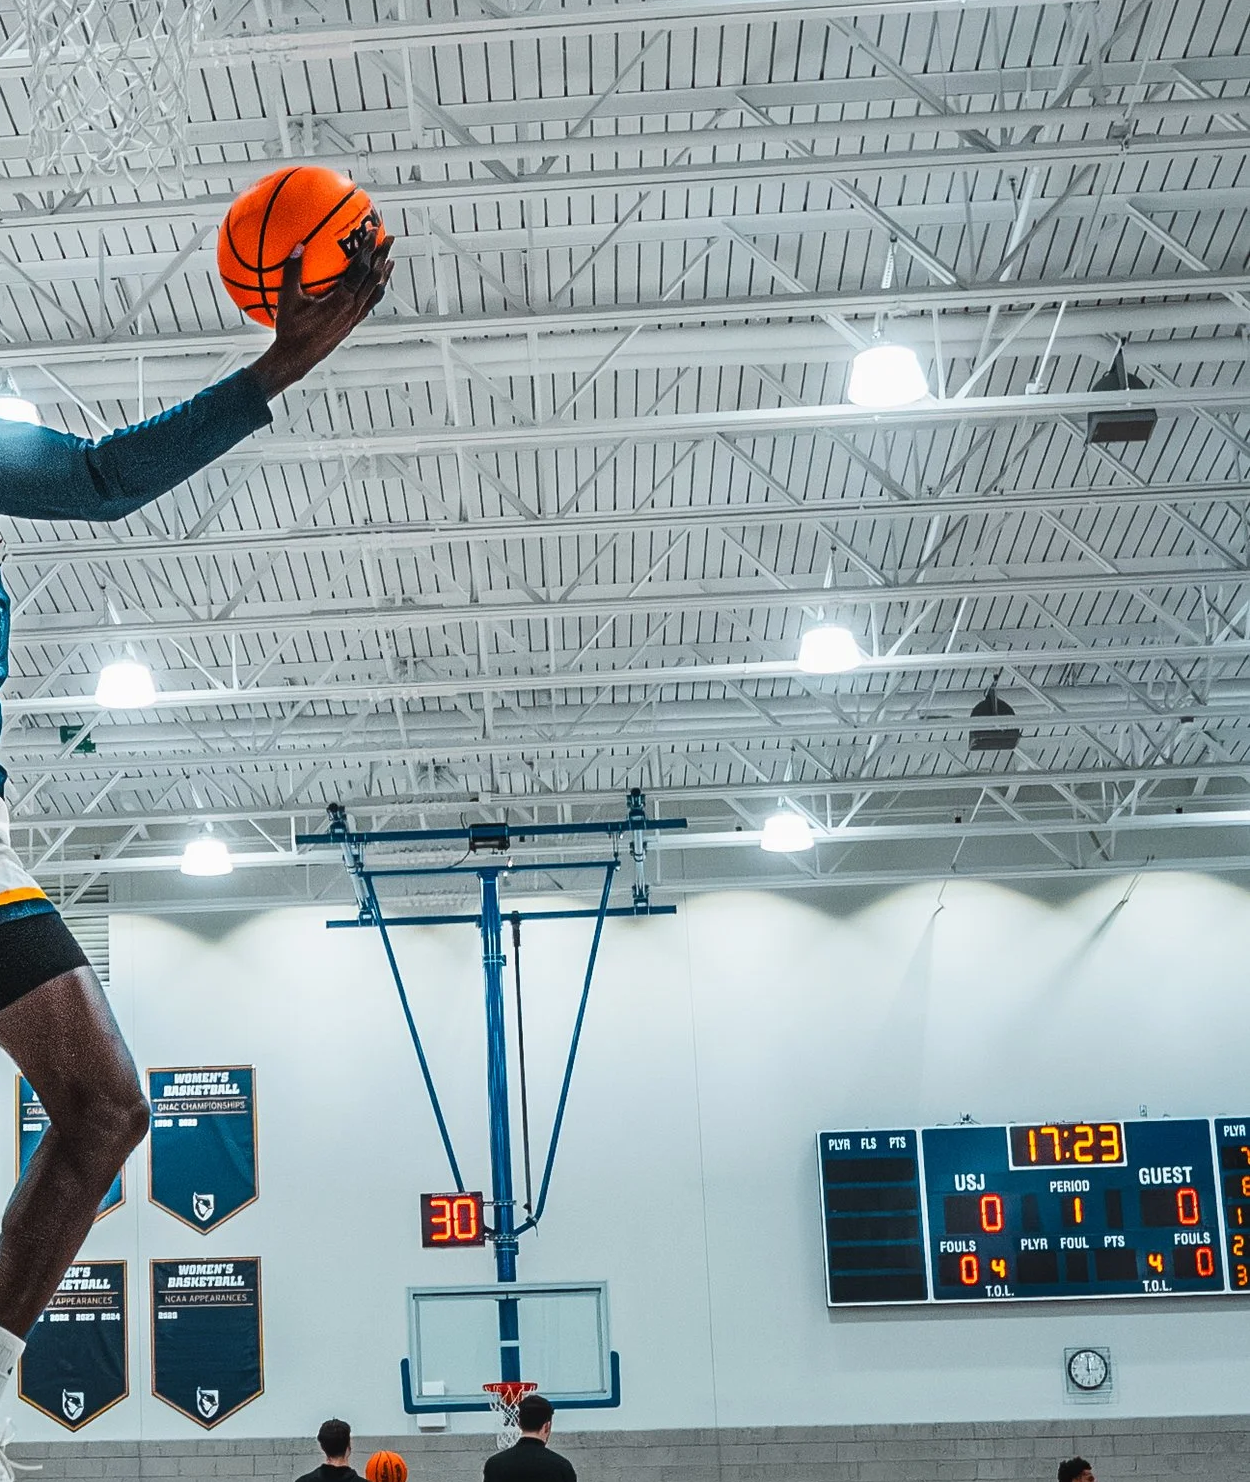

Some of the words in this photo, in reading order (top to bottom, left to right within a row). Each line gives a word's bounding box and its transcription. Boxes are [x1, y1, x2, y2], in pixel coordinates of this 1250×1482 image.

[174, 1072, 229, 1084] WOMEN'S
[163, 1083, 240, 1097] BASKETBALL
[157, 1102, 179, 1111] GNAC
[181, 1101, 245, 1111] CHAMPIONSHIPS
[1223, 1125, 1246, 1137] PLYR
[828, 1139, 850, 1151] PLYR
[861, 1138, 877, 1150] FLS
[889, 1137, 906, 1148] PTS
[1028, 1125, 1120, 1162] 17:23
[954, 1174, 986, 1191] USJ
[1138, 1166, 1193, 1185] GUEST
[1050, 1180, 1090, 1192] PERIOD
[981, 1195, 1002, 1232] 0
[1074, 1197, 1082, 1223] 1
[1177, 1188, 1198, 1225] 0
[430, 1199, 476, 1240] 30
[1020, 1238, 1048, 1251] PLYR
[1060, 1237, 1089, 1249] FOUL
[1104, 1235, 1125, 1248] PTS
[1174, 1232, 1211, 1245] FOULS
[940, 1240, 976, 1253] FOULS
[991, 1259, 1006, 1278] 4
[1148, 1253, 1163, 1273] 4
[1196, 1247, 1213, 1276] 0
[178, 1264, 234, 1276] WOMEN'S
[960, 1255, 978, 1285] 0
[167, 1275, 245, 1288] BASKETBALL
[1142, 1280, 1172, 1292] T.O.L.
[985, 1285, 1015, 1297] T.O.L.
[55, 1296, 112, 1305] APPEARANCES
[164, 1295, 187, 1303] NCAA
[189, 1294, 247, 1303] APPEARANCES
[101, 1313, 121, 1321] 2024
